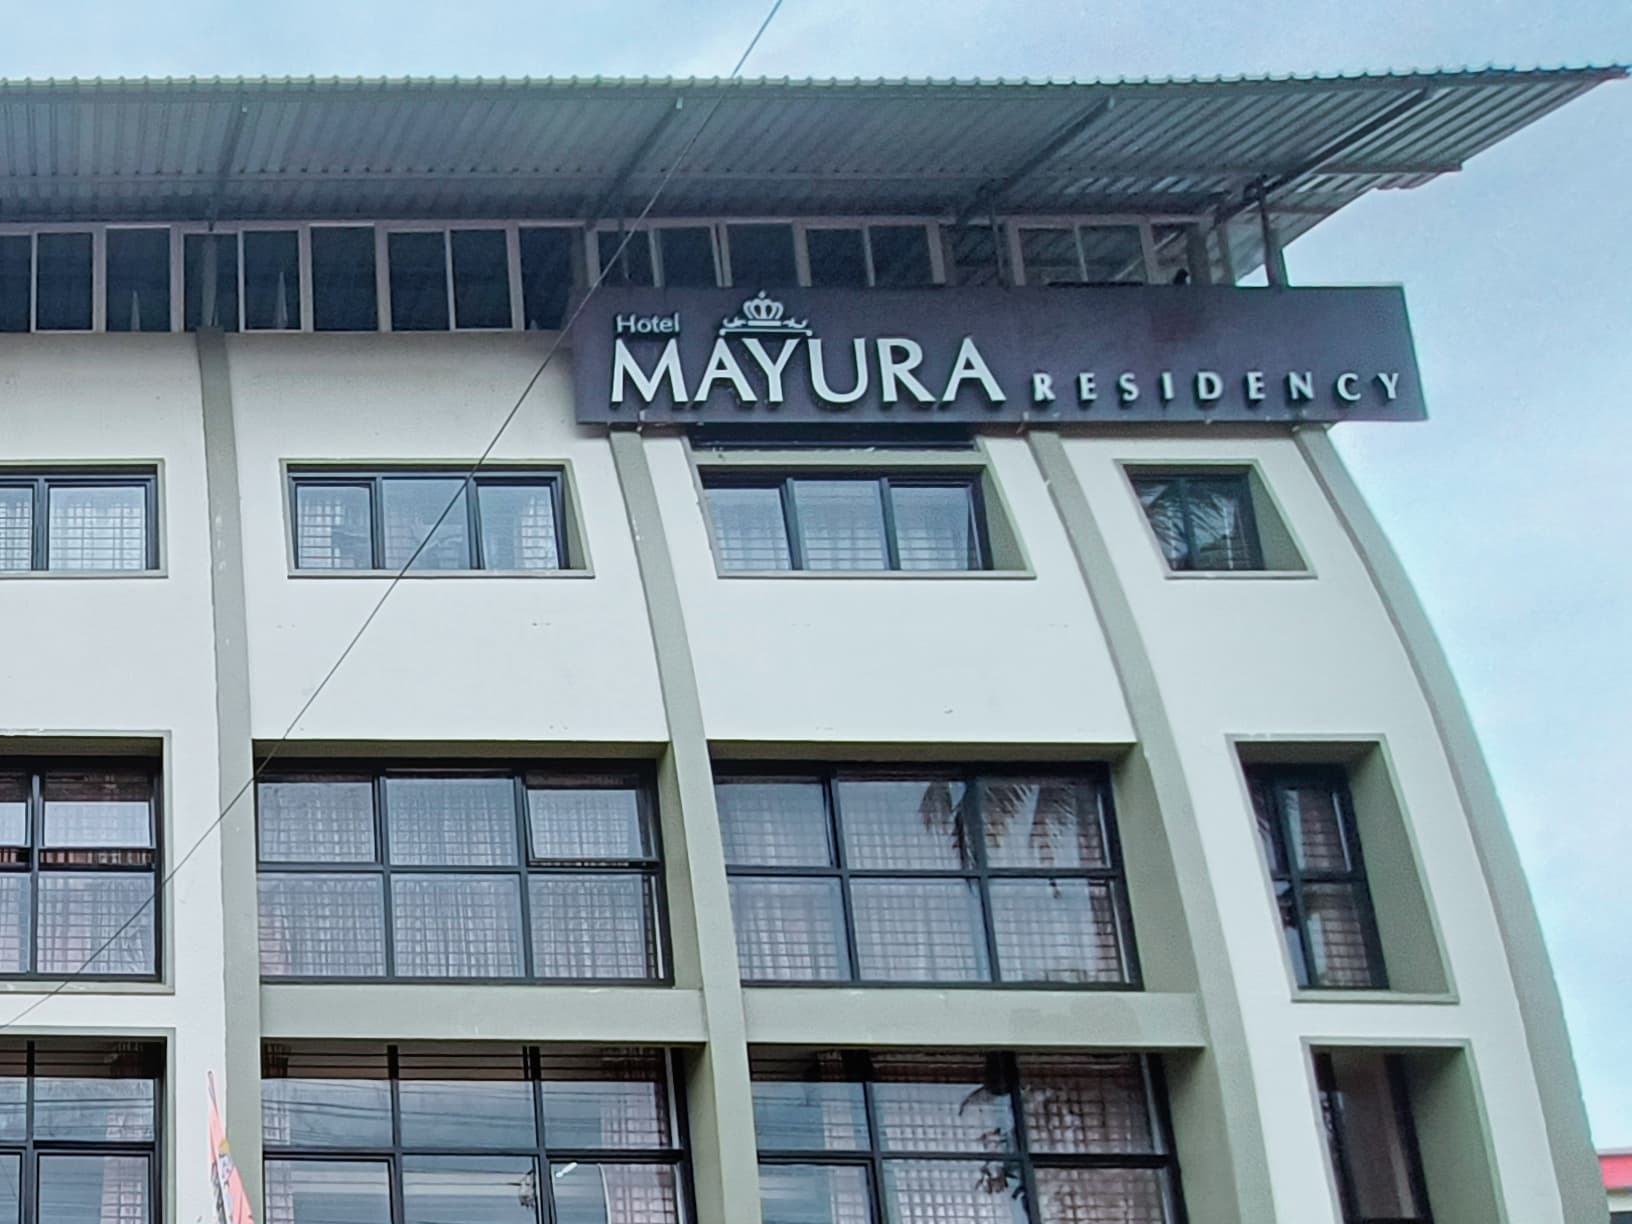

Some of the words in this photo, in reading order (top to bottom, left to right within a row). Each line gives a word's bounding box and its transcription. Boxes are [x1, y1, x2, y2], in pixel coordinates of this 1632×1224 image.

[615, 311, 682, 334] Hotel
[610, 336, 1008, 404] MAYURA
[1032, 371, 1403, 403] RESIDENCY
